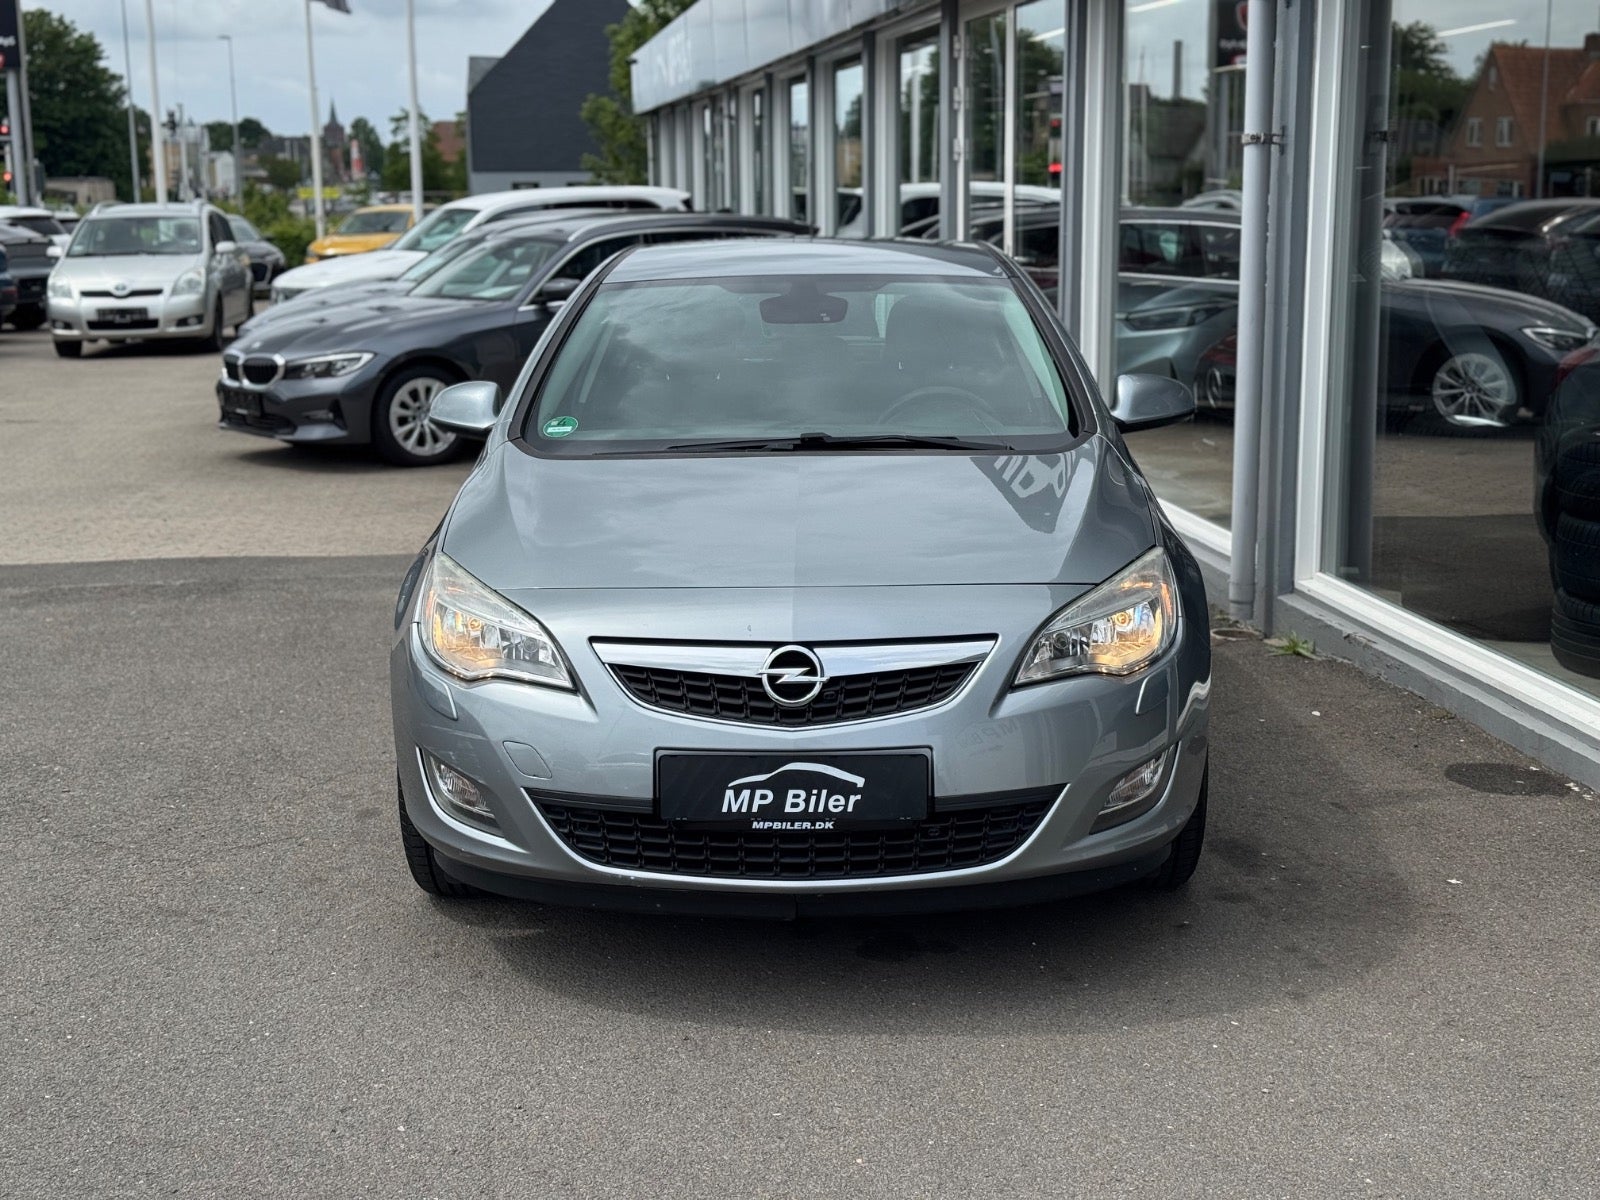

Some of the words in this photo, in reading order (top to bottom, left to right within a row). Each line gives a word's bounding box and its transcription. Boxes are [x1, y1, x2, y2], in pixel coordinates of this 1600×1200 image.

[721, 789, 774, 813] MP
[784, 789, 862, 813] Biler
[751, 821, 835, 830] MPBILER.DK
